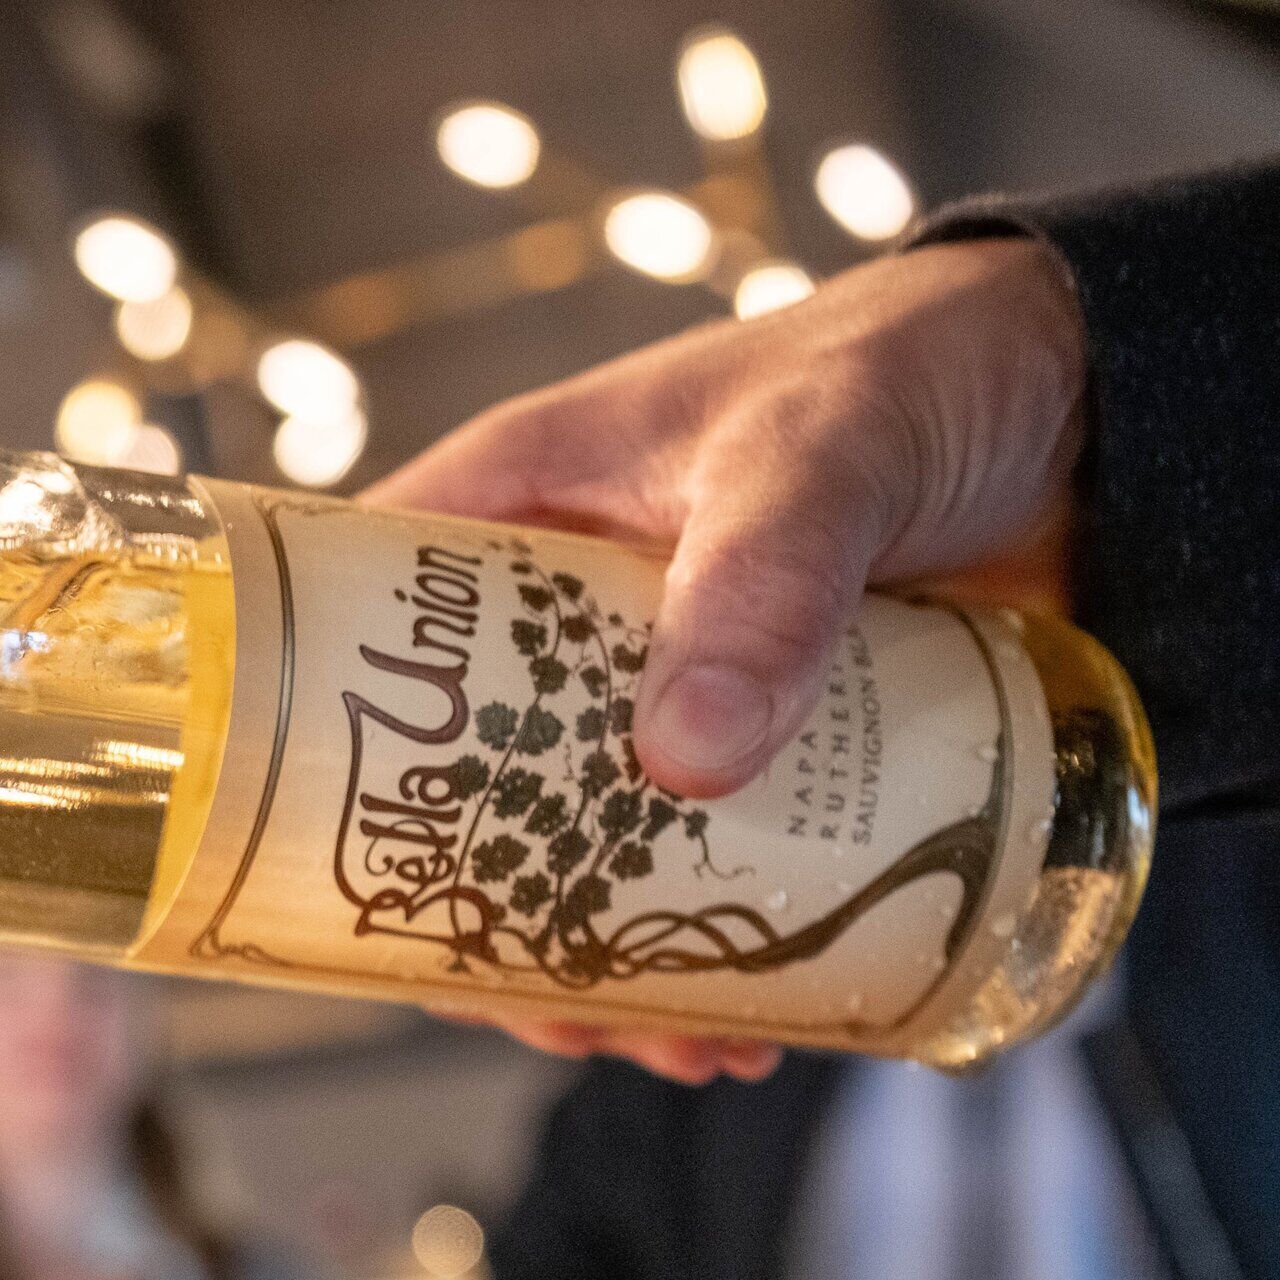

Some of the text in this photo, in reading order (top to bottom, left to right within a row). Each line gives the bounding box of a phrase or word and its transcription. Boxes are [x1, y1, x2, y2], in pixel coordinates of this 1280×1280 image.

[342, 544, 496, 962] Bella Union
[787, 732, 817, 837] NAPA
[820, 662, 849, 840] RUTHER
[853, 677, 883, 845] SAUVIGNON
